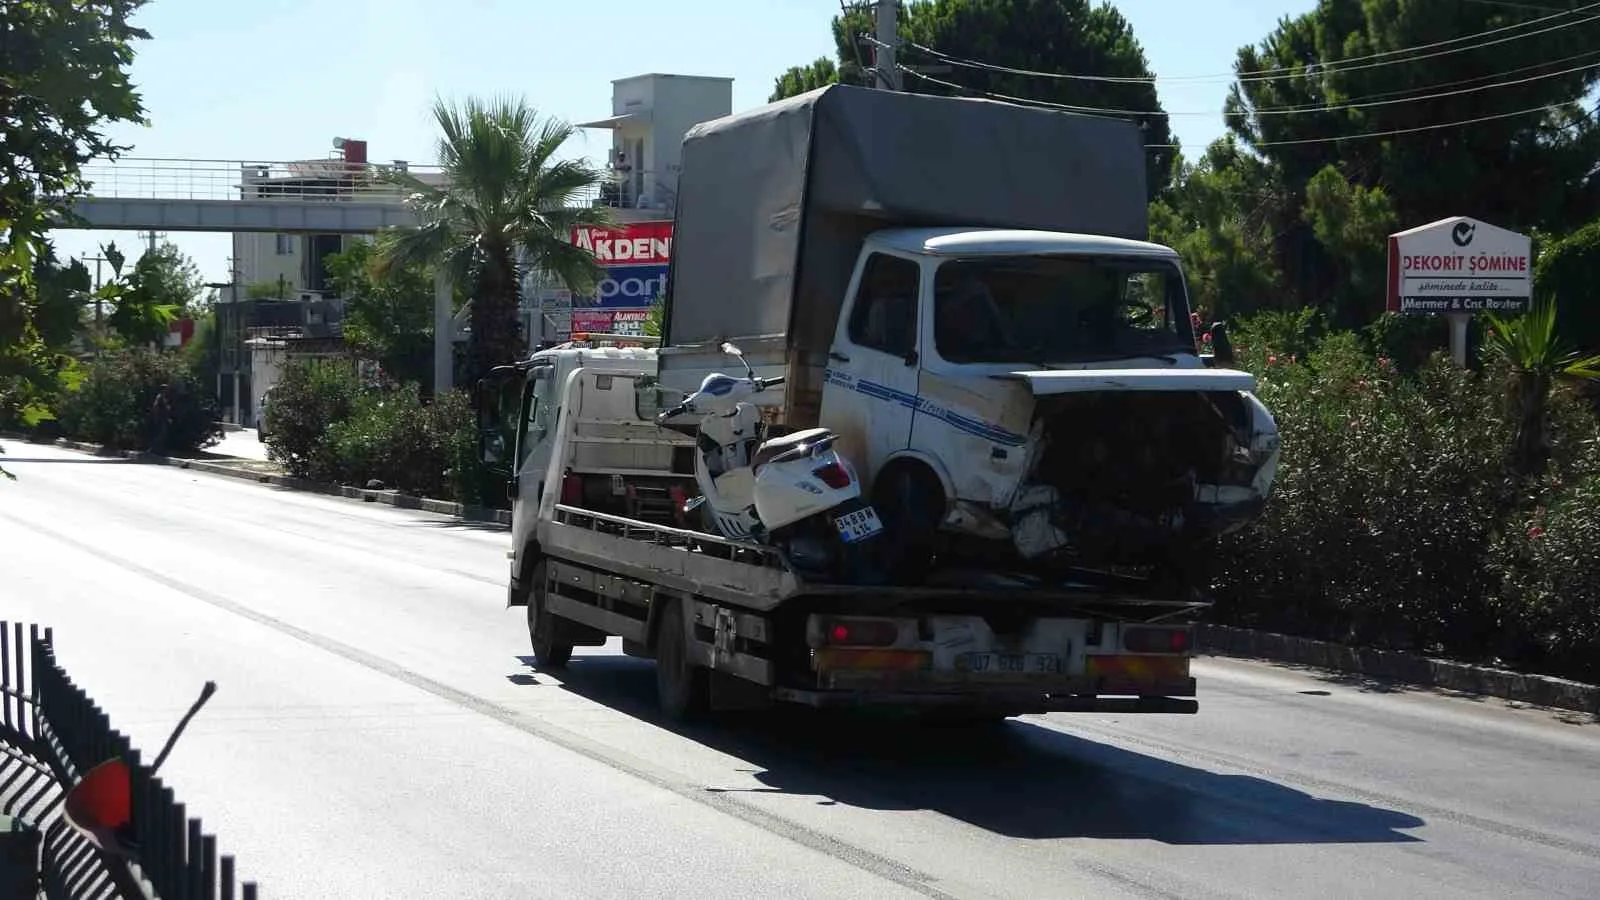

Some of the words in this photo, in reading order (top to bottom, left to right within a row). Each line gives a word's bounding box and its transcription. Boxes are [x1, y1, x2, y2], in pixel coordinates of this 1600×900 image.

[1469, 250, 1527, 275] ŞÖMİNE
[1404, 298, 1448, 309] Mermer
[1452, 299, 1460, 309] &
